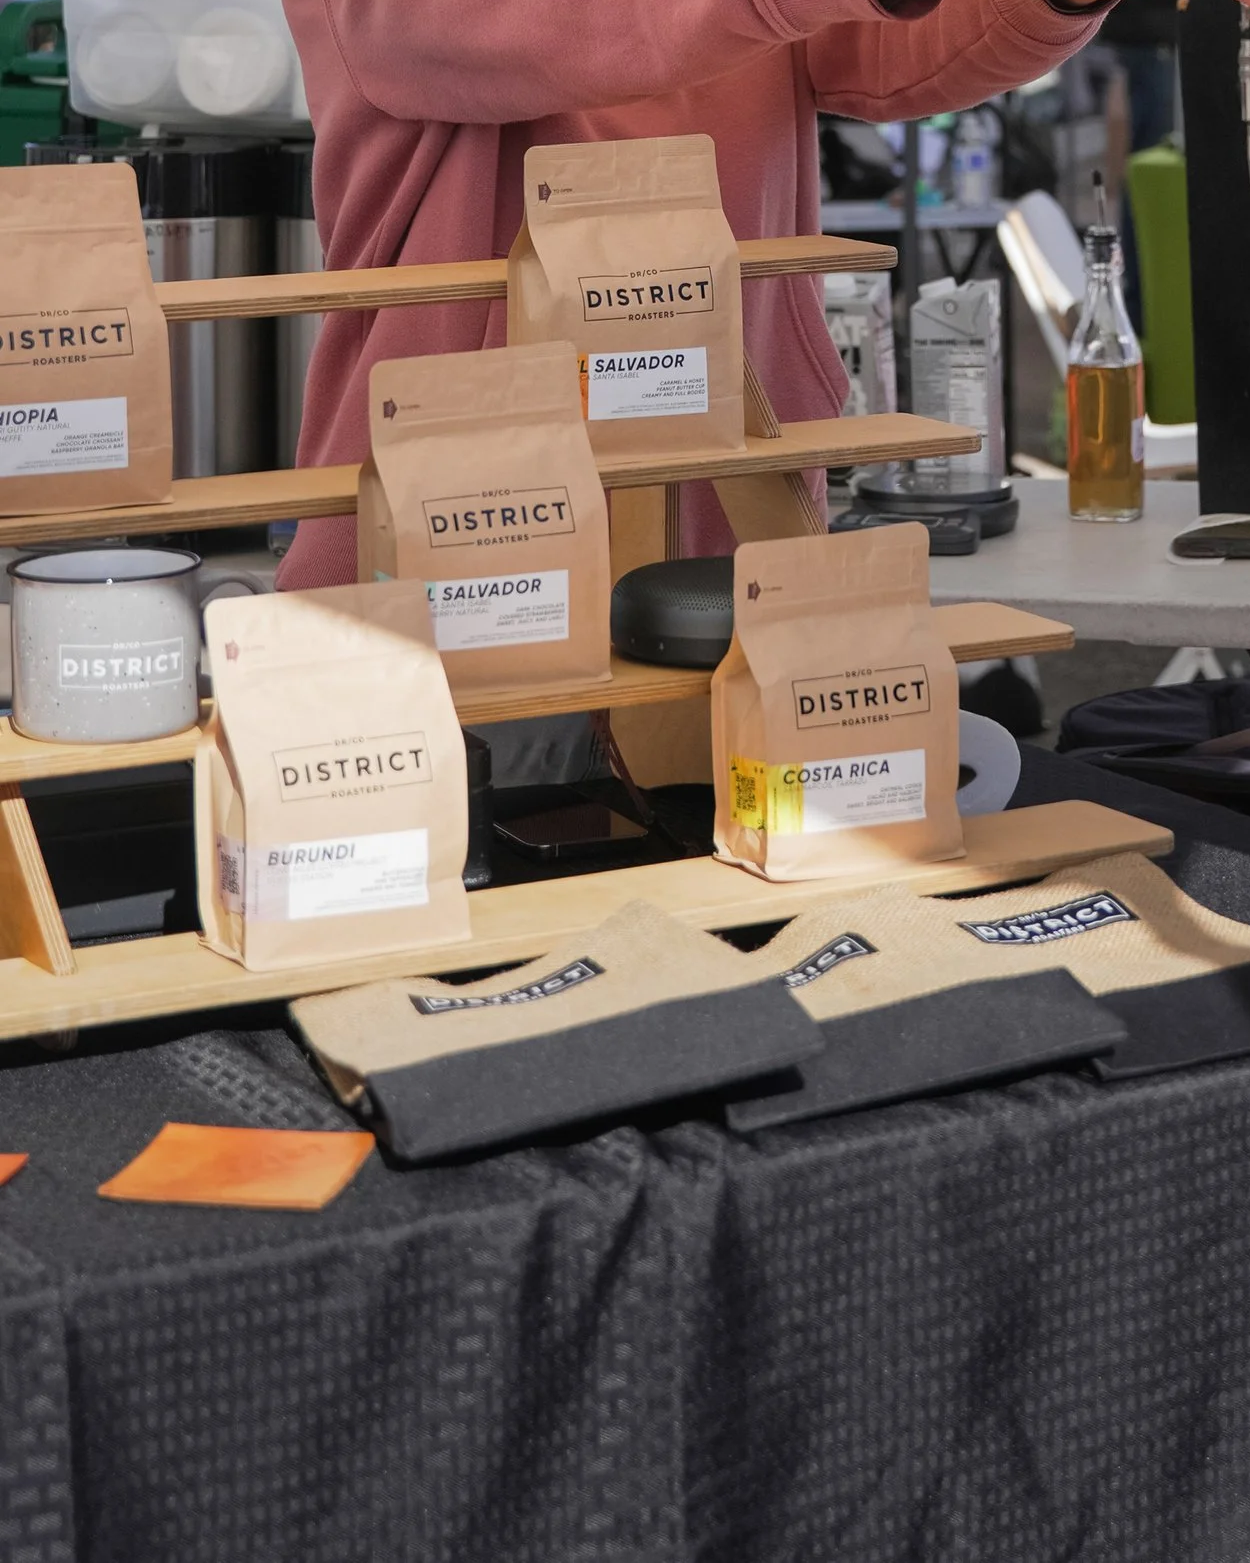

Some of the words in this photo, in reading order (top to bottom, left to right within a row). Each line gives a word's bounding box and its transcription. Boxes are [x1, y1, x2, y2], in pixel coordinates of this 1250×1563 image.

[630, 269, 657, 278] DR/CO
[586, 281, 709, 308] DISTRICT
[628, 311, 675, 321] ROASTERS
[0, 323, 126, 351] ISTRICT
[33, 355, 87, 366] ROASTERS
[577, 360, 588, 373] L
[595, 354, 685, 373] SALVADOR
[482, 489, 510, 497] DR/CO
[431, 502, 565, 533] DISTRICT
[477, 534, 529, 546] ROASTERS
[442, 578, 542, 601] SALVADOR
[62, 651, 180, 677] DISTRICT
[846, 669, 872, 678] DR/CO
[102, 681, 150, 691] ROASTERS
[799, 681, 925, 715] DISTRICT
[841, 714, 890, 726] ROASTERS
[281, 748, 424, 787] DISTRICT
[783, 765, 843, 785] COSTA
[850, 759, 890, 778] RICA
[330, 785, 386, 799] ROASTERS
[268, 843, 355, 866] BURUNDI
[976, 900, 1114, 938] DISTRICT
